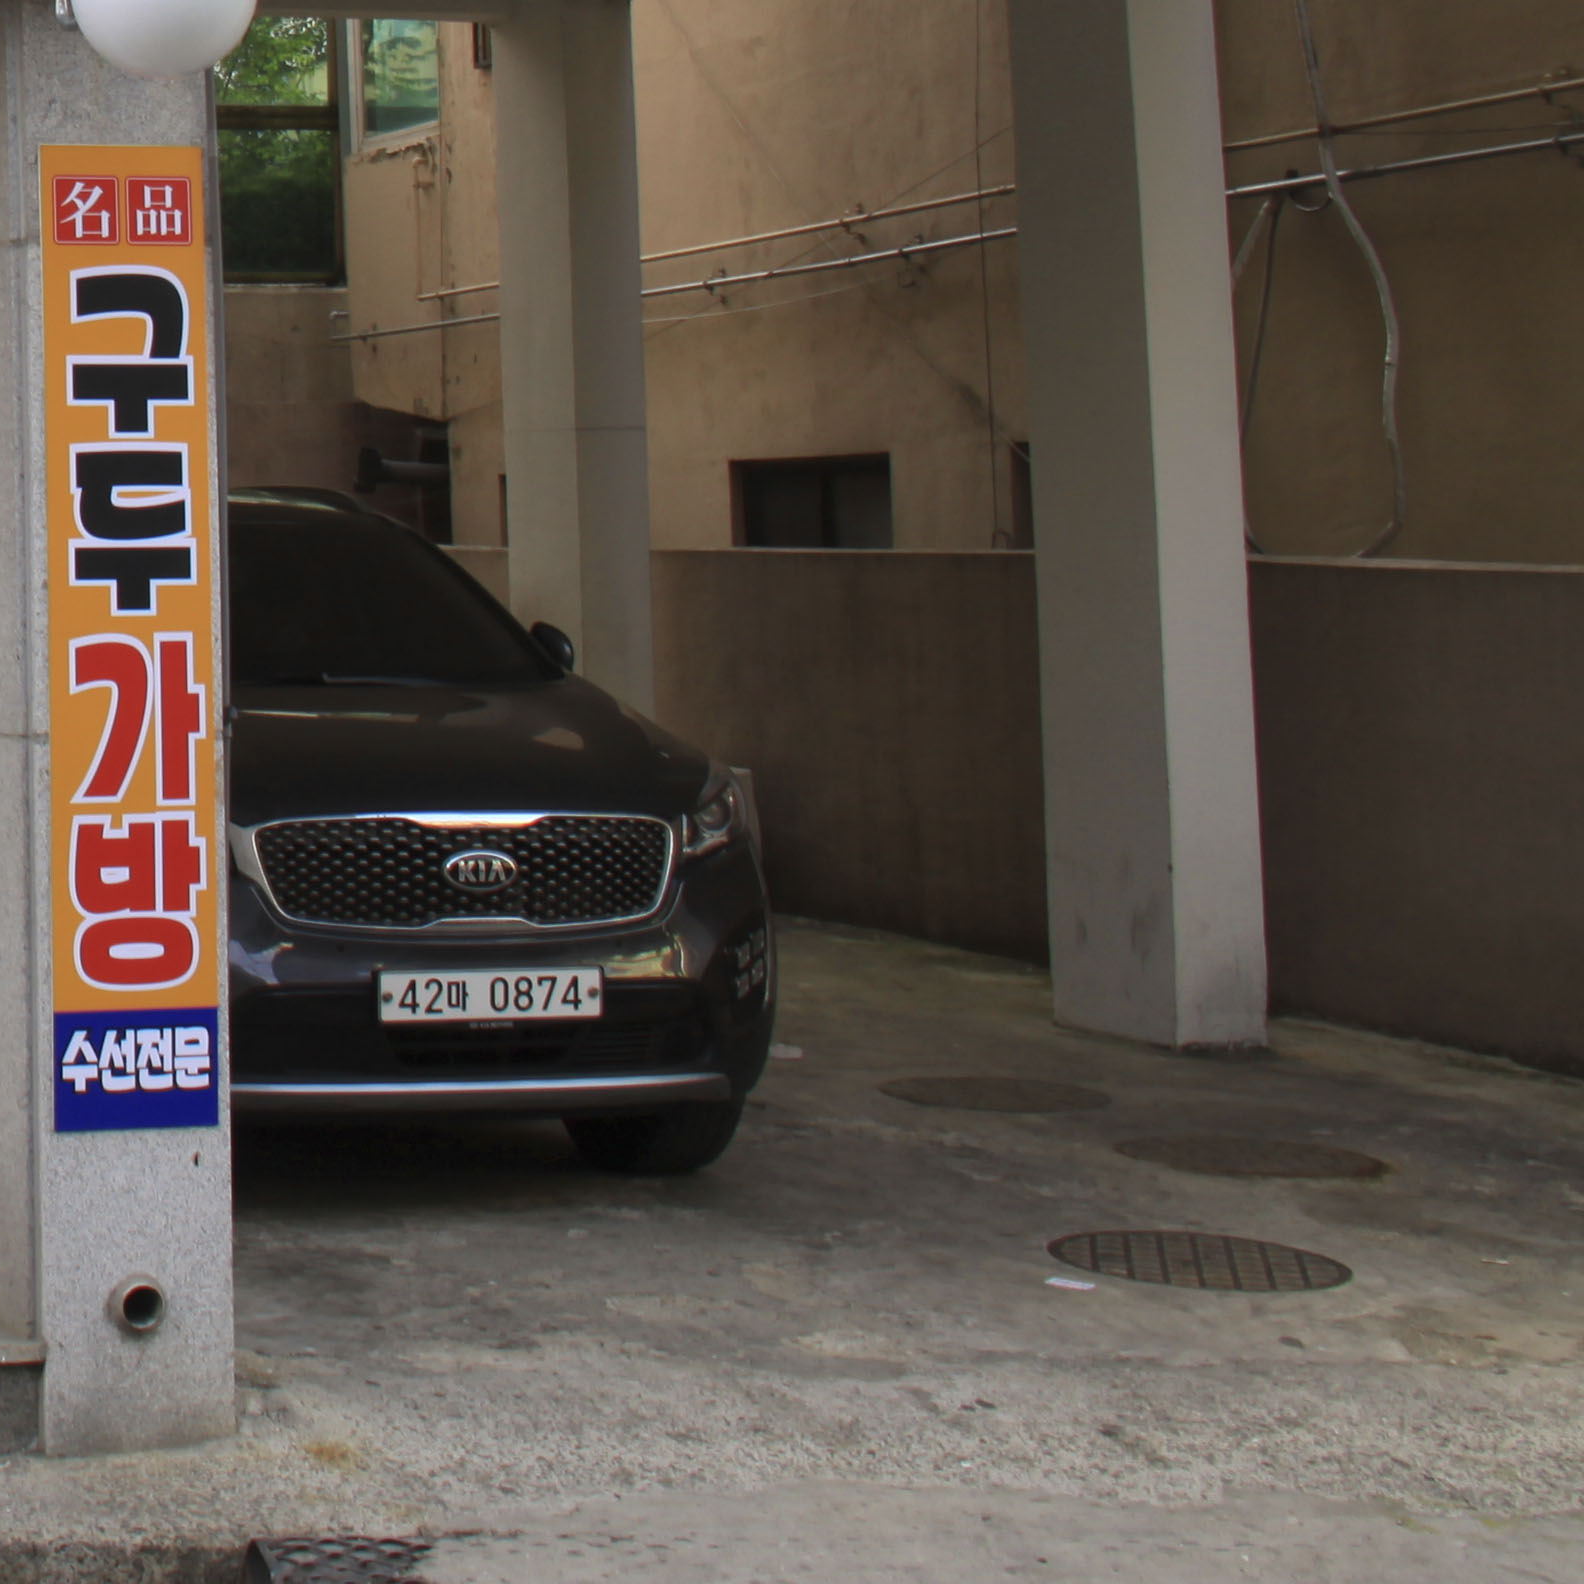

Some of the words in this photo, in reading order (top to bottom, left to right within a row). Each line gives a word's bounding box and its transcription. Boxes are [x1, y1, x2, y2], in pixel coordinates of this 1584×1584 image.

[56, 181, 185, 239] 名品
[66, 265, 198, 617] 구두
[67, 630, 207, 993] 가방
[456, 859, 507, 883] KIA
[398, 977, 470, 1015] 42마
[489, 974, 583, 1013] 0874
[60, 1025, 211, 1096] 수선전문
